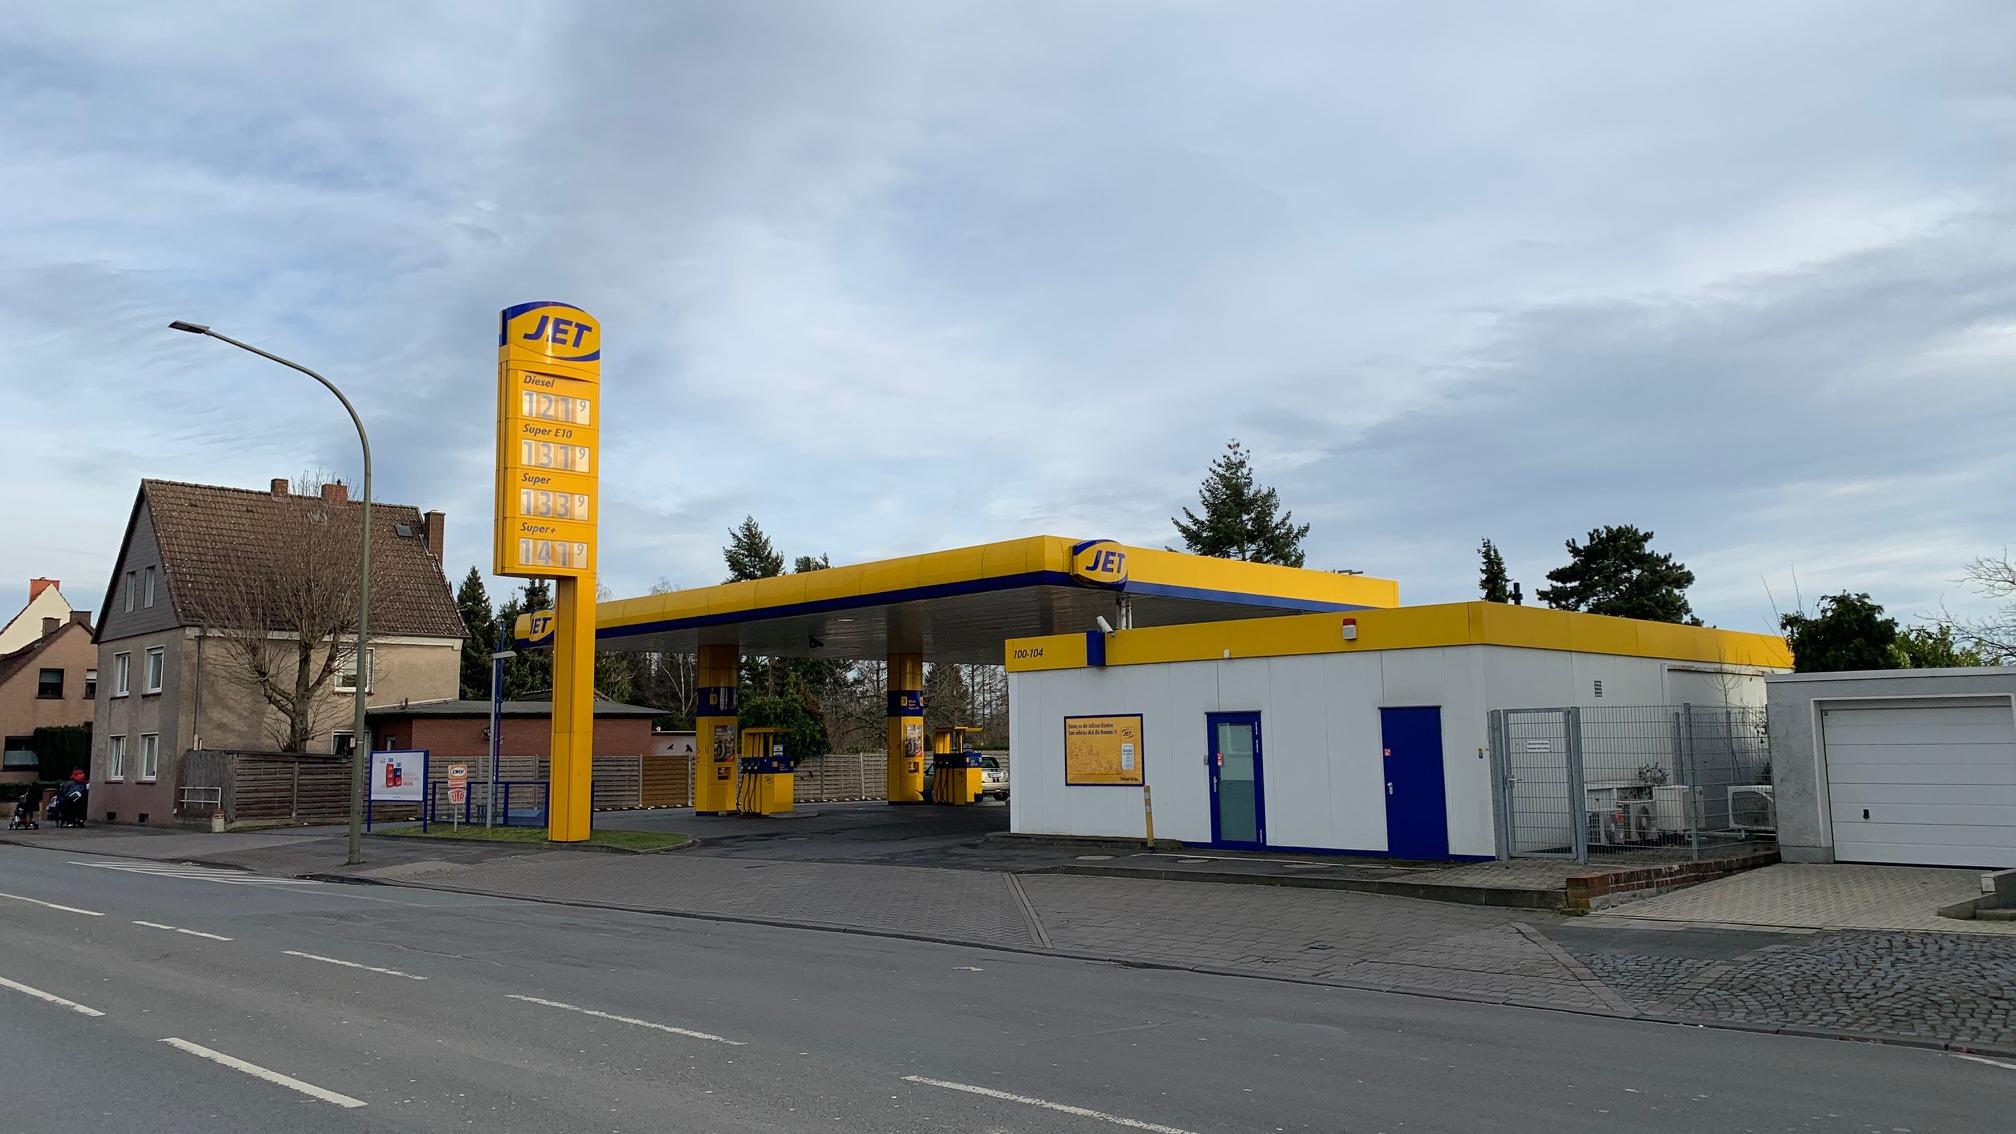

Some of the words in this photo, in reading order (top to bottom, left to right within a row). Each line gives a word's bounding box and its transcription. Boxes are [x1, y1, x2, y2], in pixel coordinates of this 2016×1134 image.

[523, 315, 593, 348] JET
[523, 374, 555, 388] Diesel
[522, 424, 552, 440] Super
[554, 428, 573, 439] E10
[521, 472, 551, 486] Super
[520, 522, 557, 535] Super+
[1085, 549, 1126, 574] JET
[1013, 648, 1044, 659] 100-104
